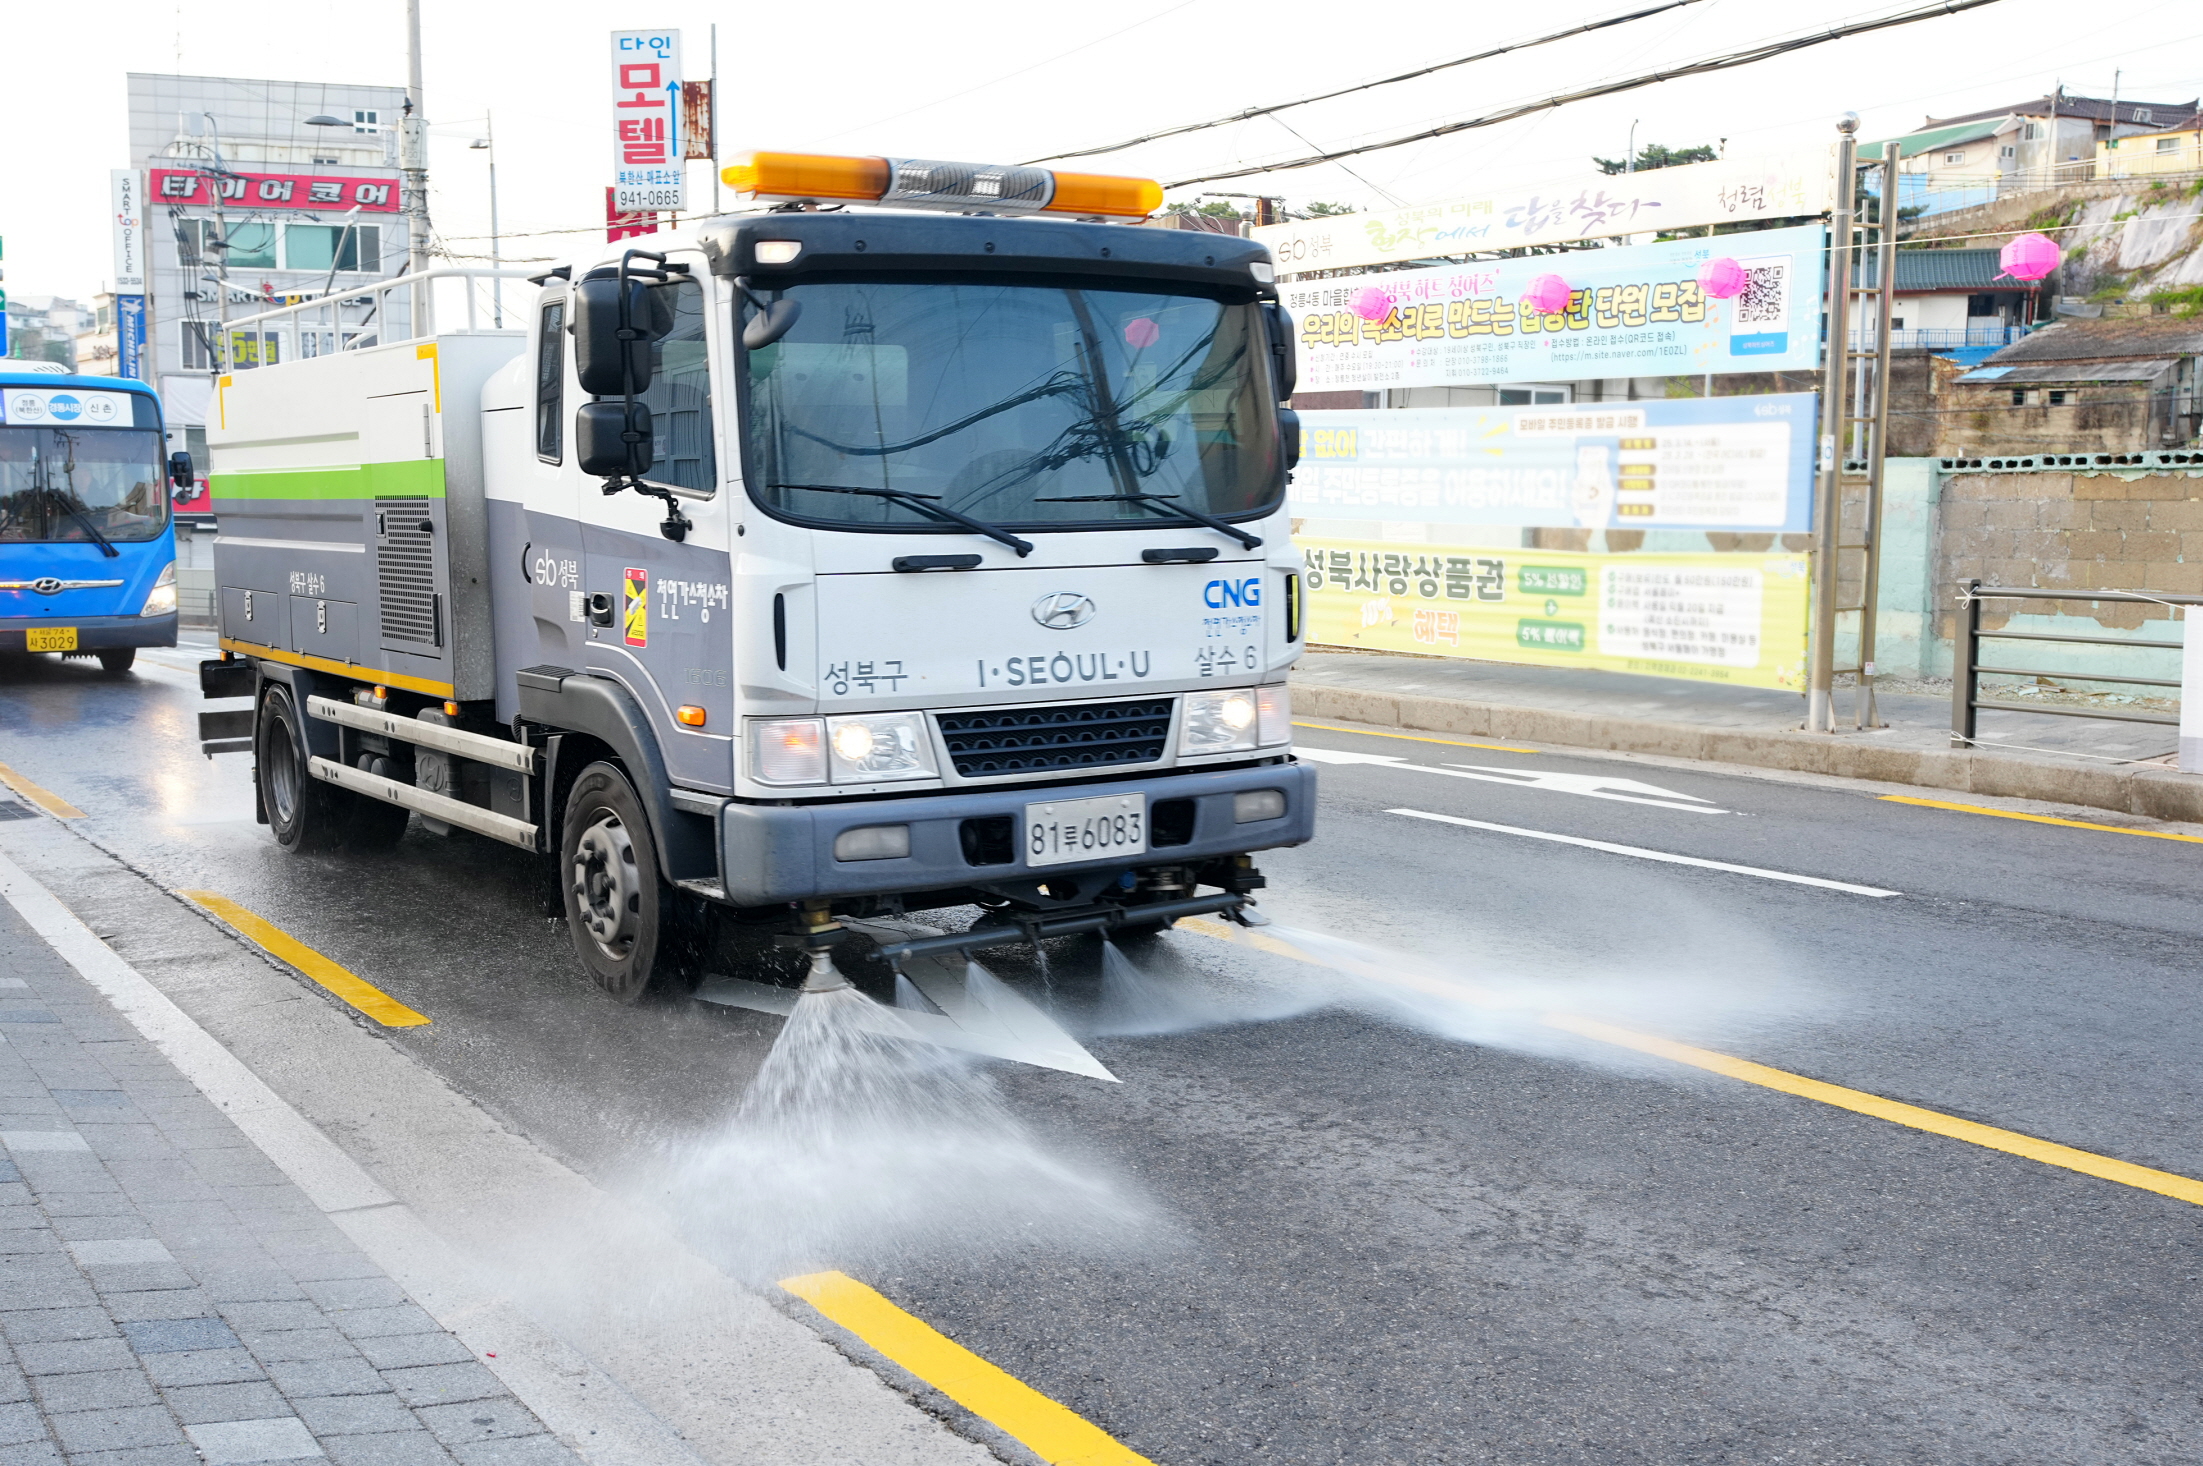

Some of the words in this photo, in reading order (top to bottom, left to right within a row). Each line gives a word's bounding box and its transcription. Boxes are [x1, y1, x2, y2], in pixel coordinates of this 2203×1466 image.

[620, 37, 670, 58] 다인
[617, 63, 666, 164] 모텔
[160, 175, 390, 206] 타이어코어
[619, 170, 643, 186] 북한산
[122, 178, 131, 215] SMART
[620, 190, 679, 206] 941-0665
[1718, 186, 1767, 212] 청렴
[1395, 207, 1443, 227] 성북의
[1451, 200, 1494, 218] 미래
[1503, 195, 1566, 236] 답을
[1569, 189, 1662, 236] 찾다
[123, 228, 132, 273] OFFICE
[1308, 234, 1333, 259] 성북
[1290, 291, 1320, 308] 정릉4동
[1415, 278, 1446, 300] 하트
[1301, 310, 1359, 349] 우리의
[1446, 296, 1516, 339] 만드는
[1595, 283, 1650, 328] 단원
[1650, 279, 1706, 323] 모집
[127, 315, 137, 379] MICHELIN
[1551, 338, 1580, 348] 접수방법
[1586, 336, 1608, 347] 온라인
[1657, 331, 1676, 343] 접속)
[1519, 418, 1546, 430] 모바일
[1548, 417, 1593, 430] 주민등록증
[1618, 415, 1639, 428] 시행
[1314, 429, 1357, 458] 없이
[1322, 466, 1441, 508] 주민등록증을
[290, 570, 307, 594] 성북구
[307, 572, 320, 596] 살수
[320, 574, 325, 594] 6
[558, 560, 579, 590] 성북
[1303, 547, 1504, 602] 성북사랑상품권
[1523, 572, 1544, 588] 5%
[656, 578, 729, 624] 천연가스청소차
[1204, 577, 1262, 609] CNG
[1413, 608, 1459, 647] 혜택
[1521, 626, 1541, 642] 5%
[40, 636, 75, 650] 3029
[1195, 645, 1238, 678] 살수
[1244, 645, 1258, 670] 6
[824, 659, 908, 696] 성북구
[1031, 812, 1142, 855] 81루6083
